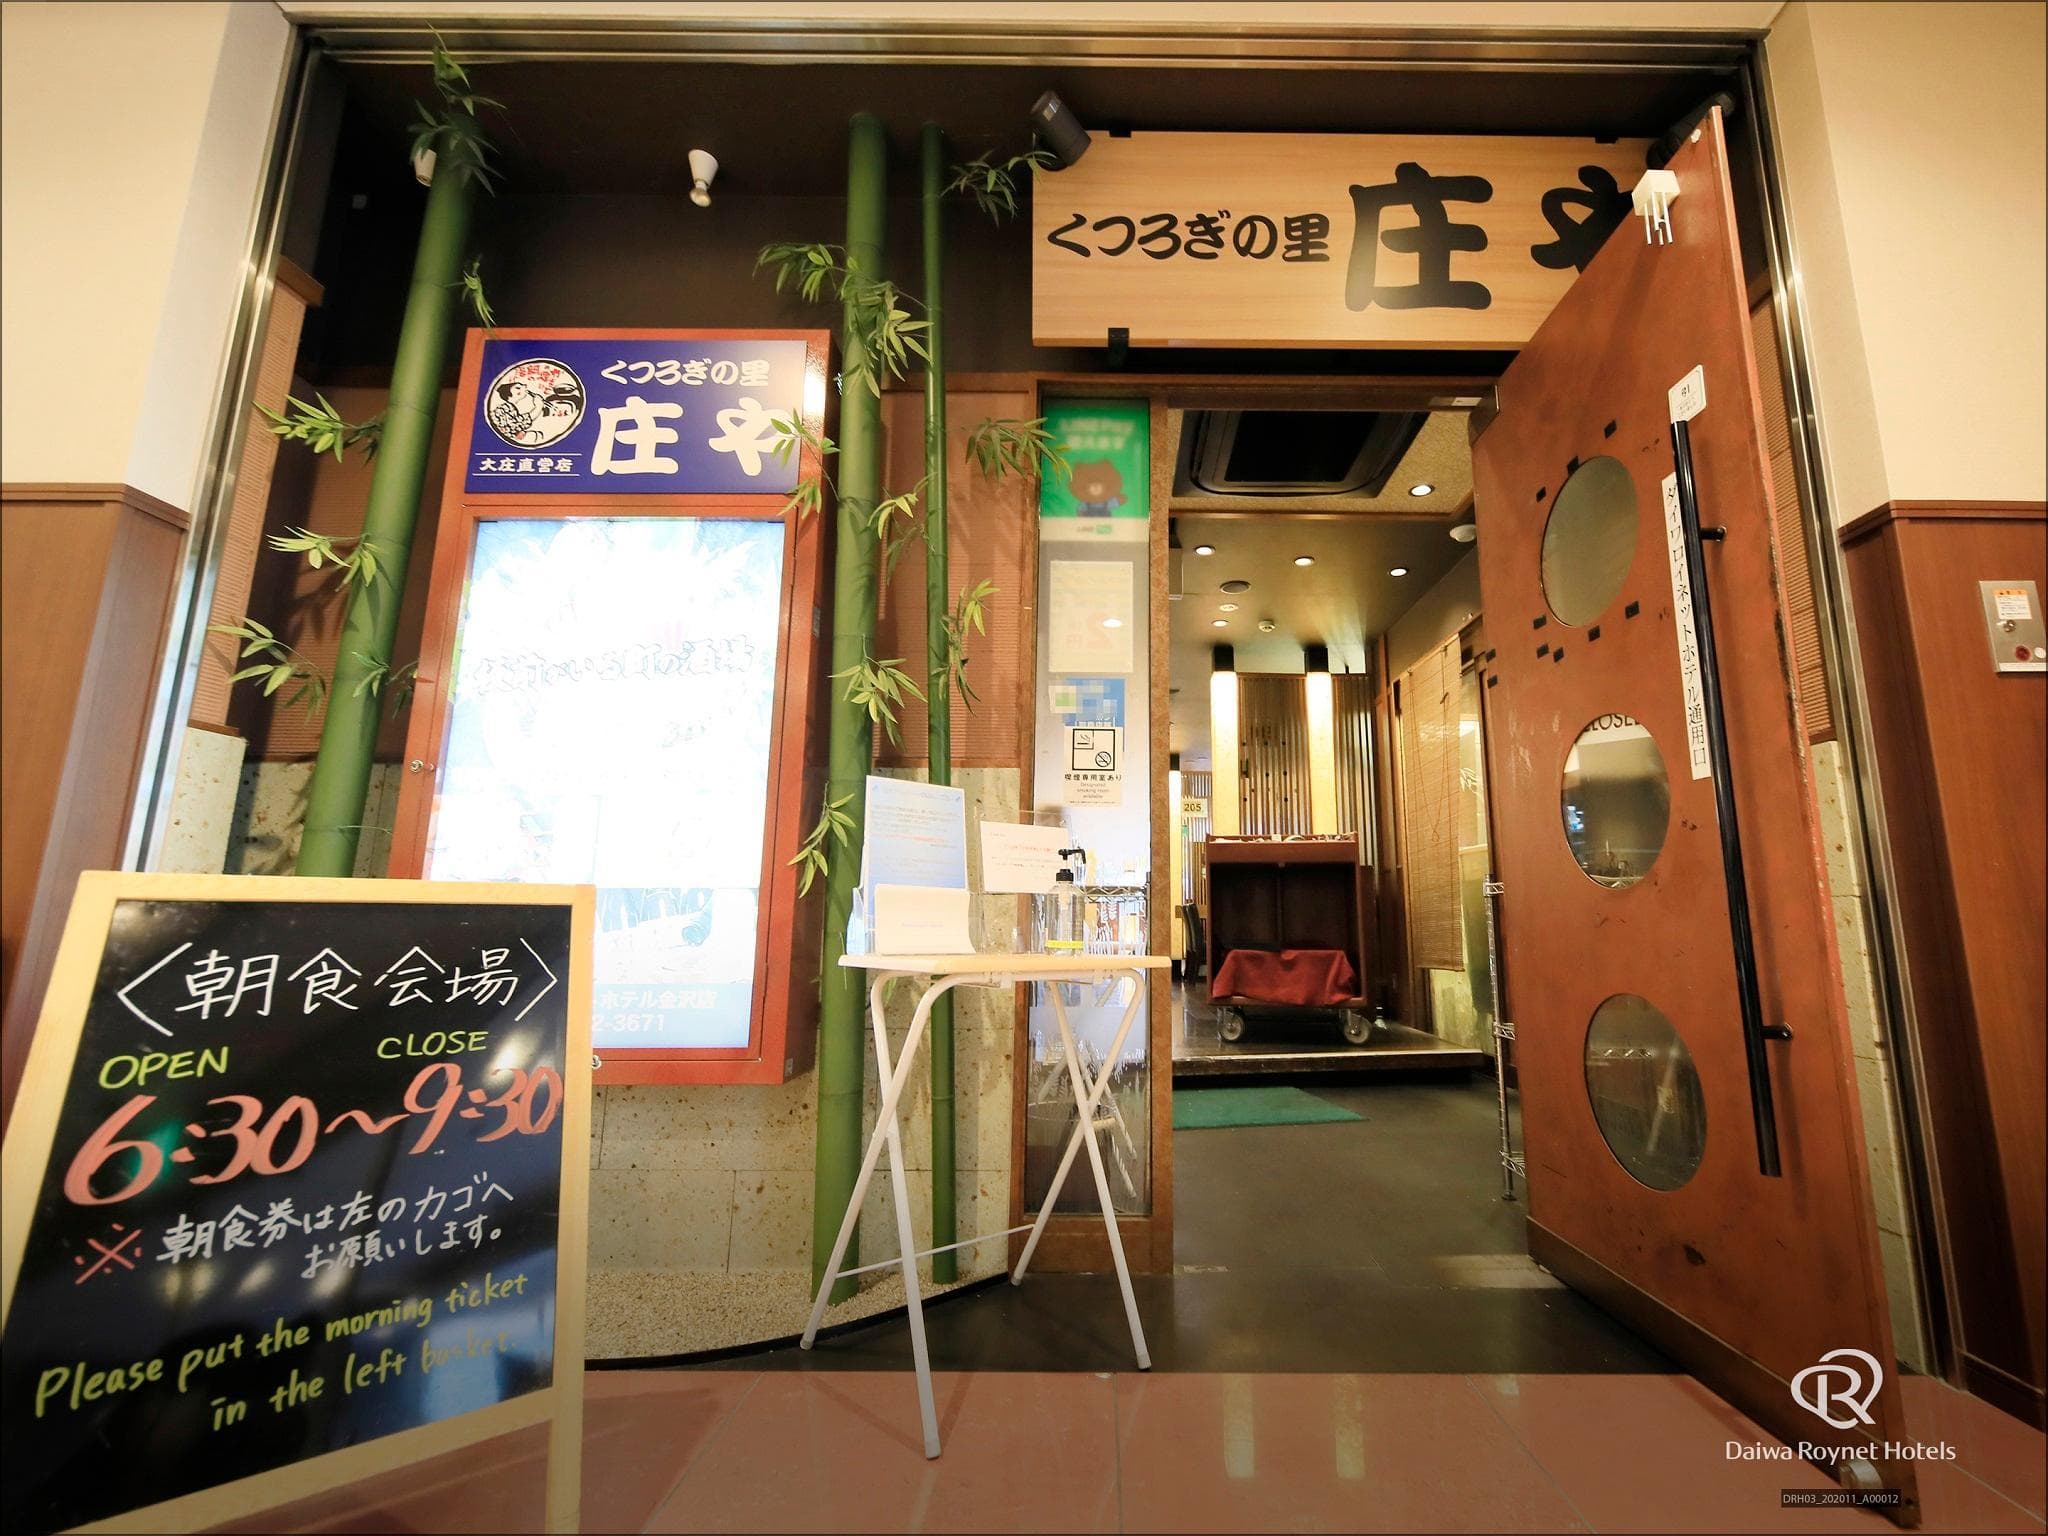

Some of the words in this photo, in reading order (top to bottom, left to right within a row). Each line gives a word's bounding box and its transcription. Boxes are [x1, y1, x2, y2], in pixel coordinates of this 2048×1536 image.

[1047, 209, 1331, 264] くつろぎの里
[599, 358, 771, 387] くつろぎの里
[479, 456, 574, 473] 大庄直営店
[590, 395, 797, 476] 庄や
[1666, 483, 1707, 766] ダイワロイネットホテル通用口
[1583, 713, 1640, 732] LOSE
[1183, 803, 1202, 812] 205
[100, 1046, 229, 1090] OPEN
[376, 1030, 489, 1060] CLOSE
[301, 1214, 502, 1279] お願いします。
[34, 1356, 163, 1418] Please
[178, 1337, 244, 1392] put
[256, 1317, 310, 1357] the
[325, 1293, 433, 1343] morning
[445, 1272, 529, 1314] ticket
[211, 1396, 247, 1432] in
[269, 1369, 324, 1414] the
[344, 1353, 408, 1393] left
